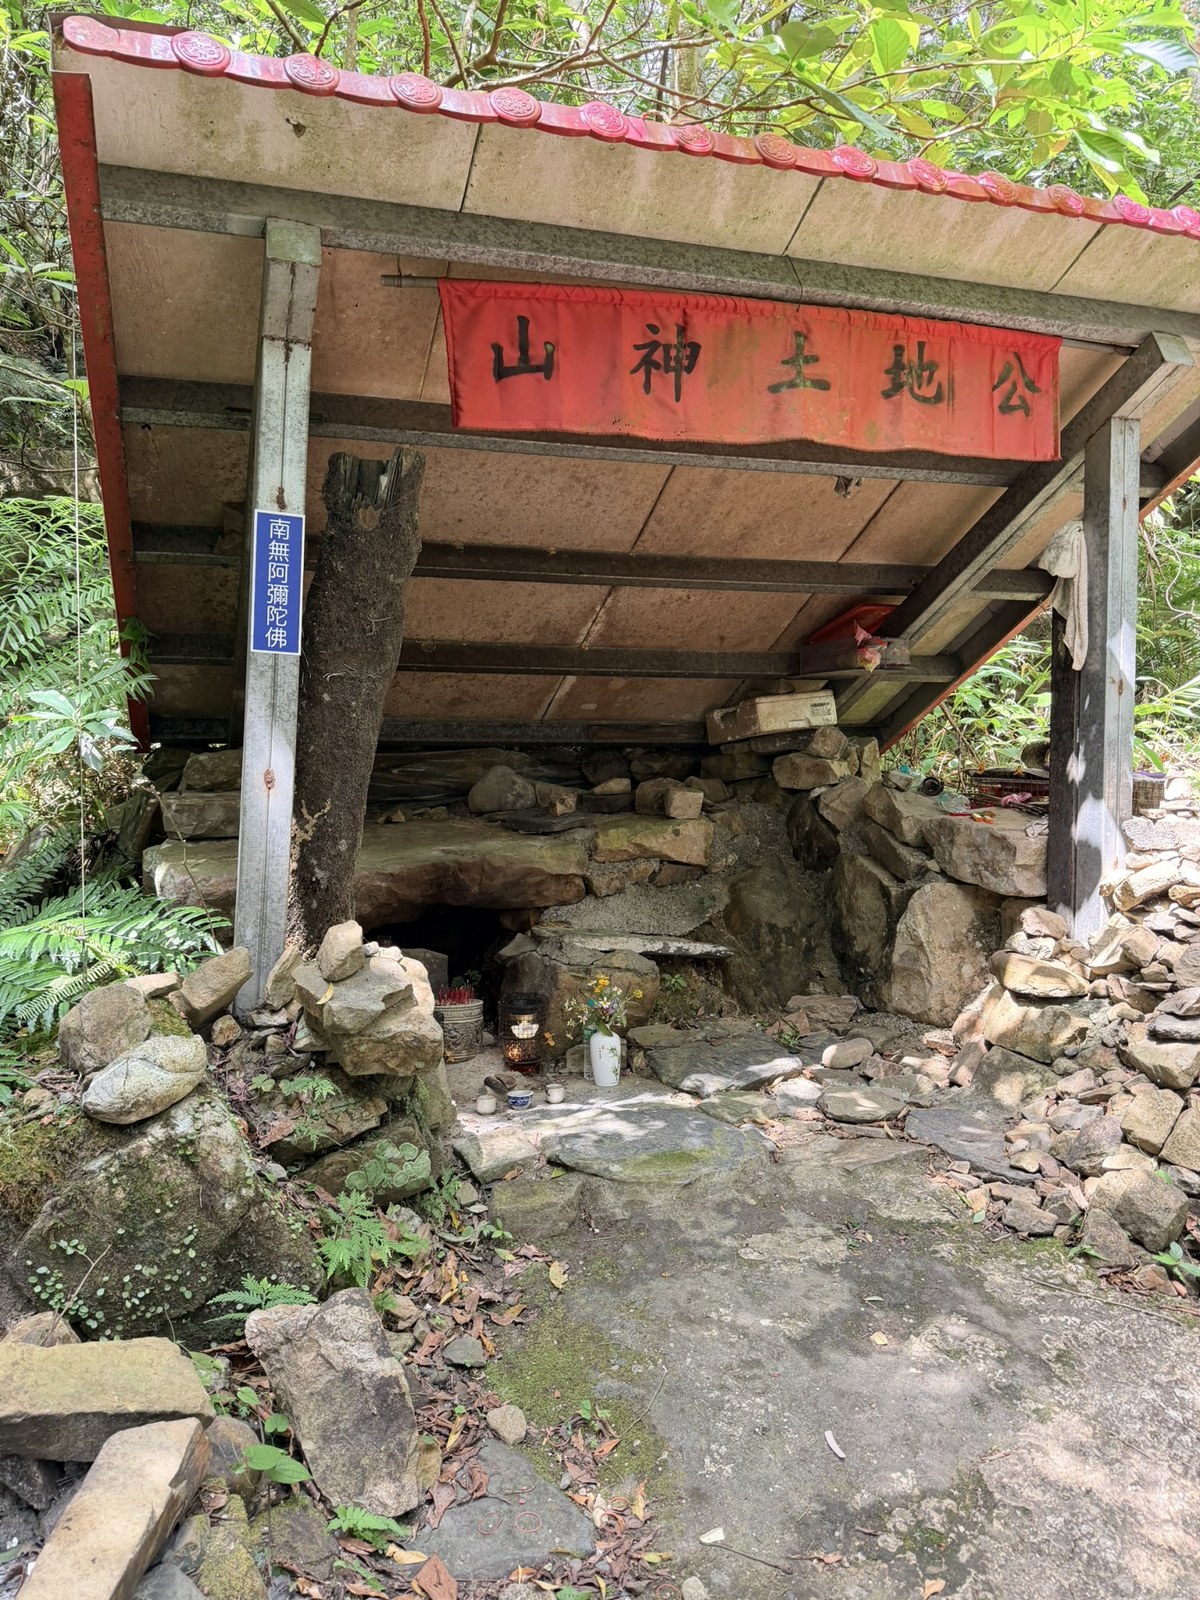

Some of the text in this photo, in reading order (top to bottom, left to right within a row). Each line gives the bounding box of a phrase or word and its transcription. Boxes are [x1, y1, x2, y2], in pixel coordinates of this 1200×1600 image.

[492, 314, 1041, 417] 山神土地公
[265, 518, 291, 648] 南無阿彌陀佛
